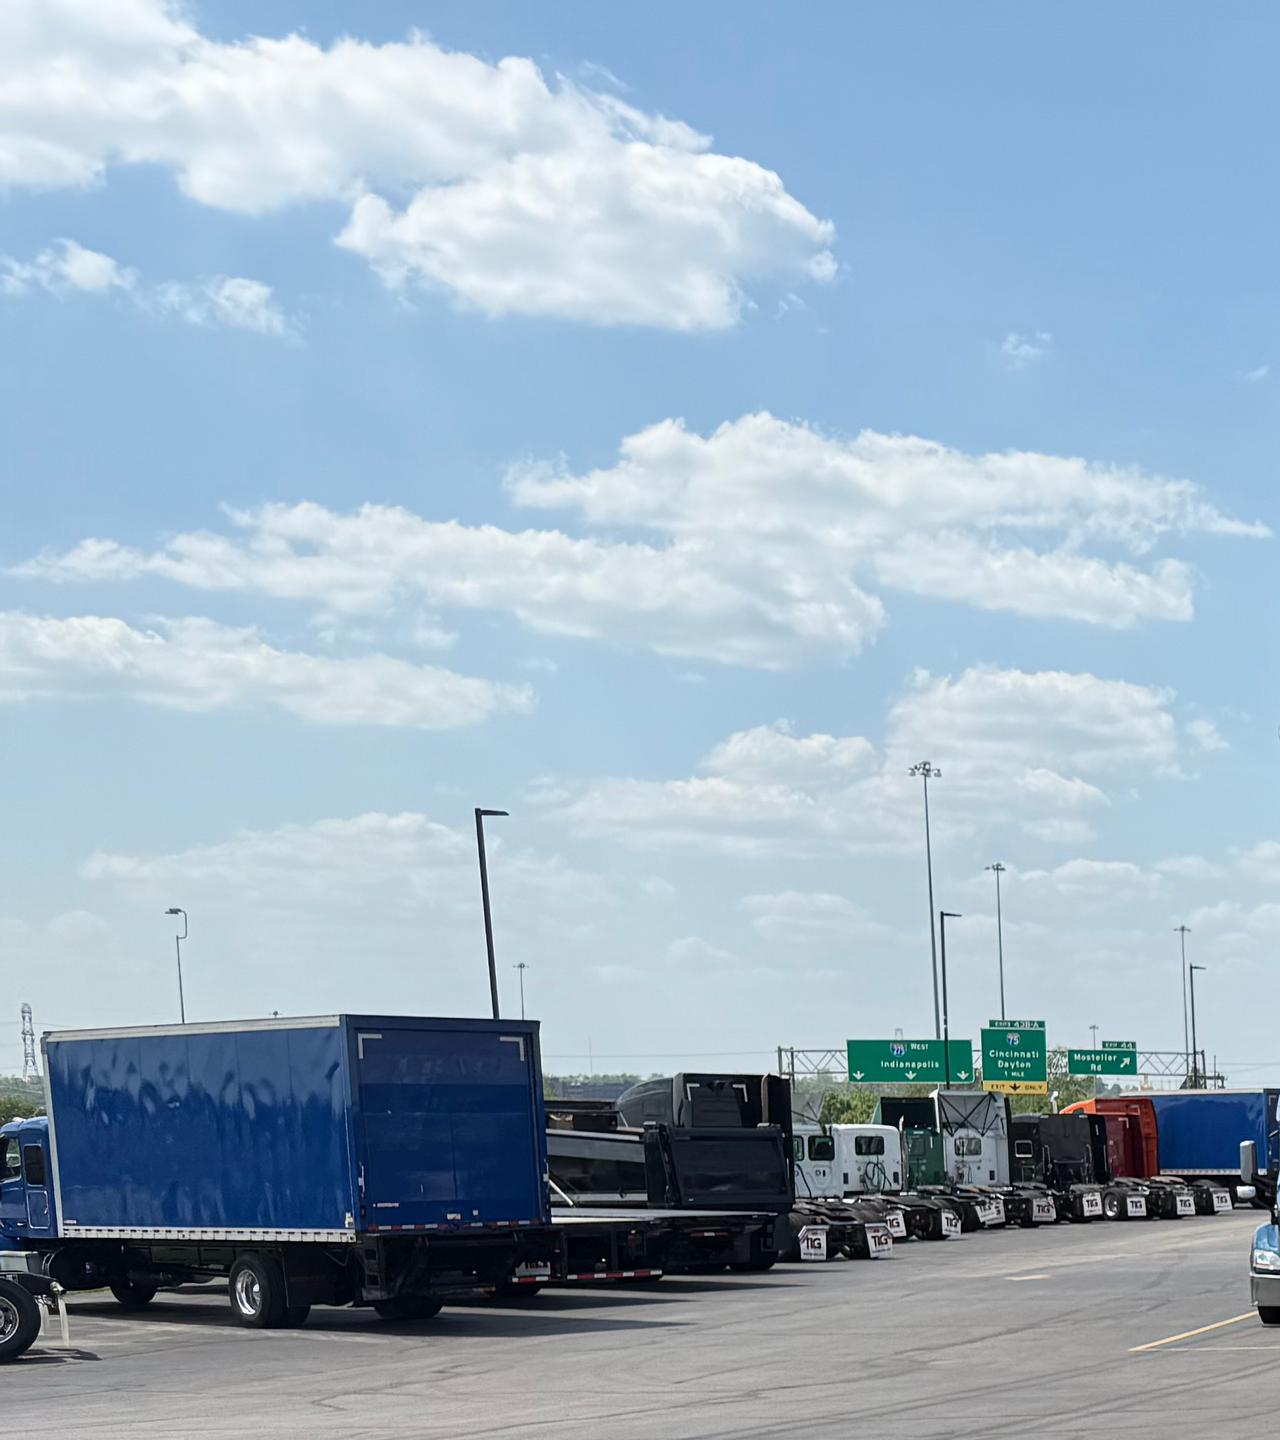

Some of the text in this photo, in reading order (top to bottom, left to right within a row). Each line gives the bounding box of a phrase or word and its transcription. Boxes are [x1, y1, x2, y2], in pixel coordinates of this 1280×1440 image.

[989, 1049, 1039, 1059] Cincinnati
[880, 1060, 940, 1070] Indianapolis
[997, 1060, 1032, 1070] Dayton
